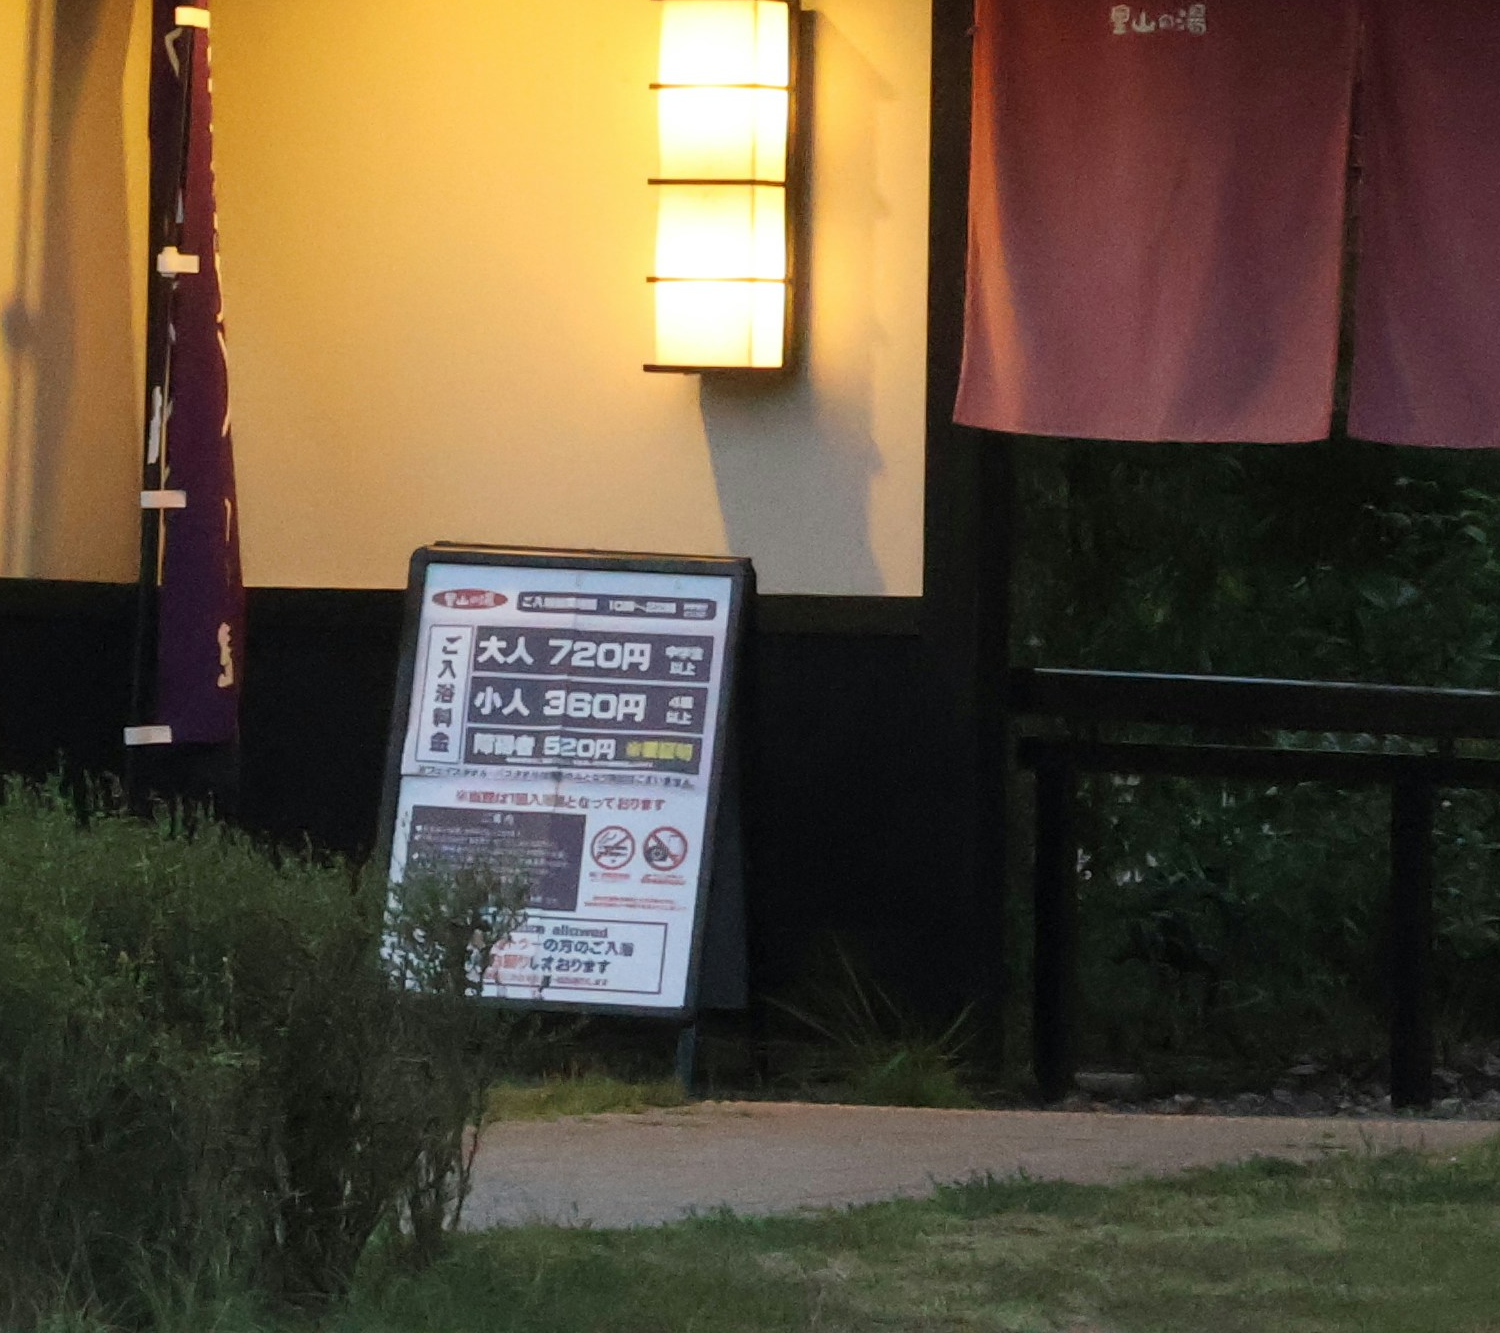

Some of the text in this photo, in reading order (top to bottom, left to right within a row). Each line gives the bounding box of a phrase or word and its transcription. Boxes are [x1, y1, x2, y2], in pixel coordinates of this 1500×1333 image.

[1111, 4, 1207, 35] 里山の湯
[476, 635, 534, 666] 大人
[548, 639, 652, 672] 720円
[429, 635, 462, 753] ご入浴料金
[473, 686, 531, 717] 小人
[542, 689, 647, 723] 360円
[543, 735, 617, 760] 520円
